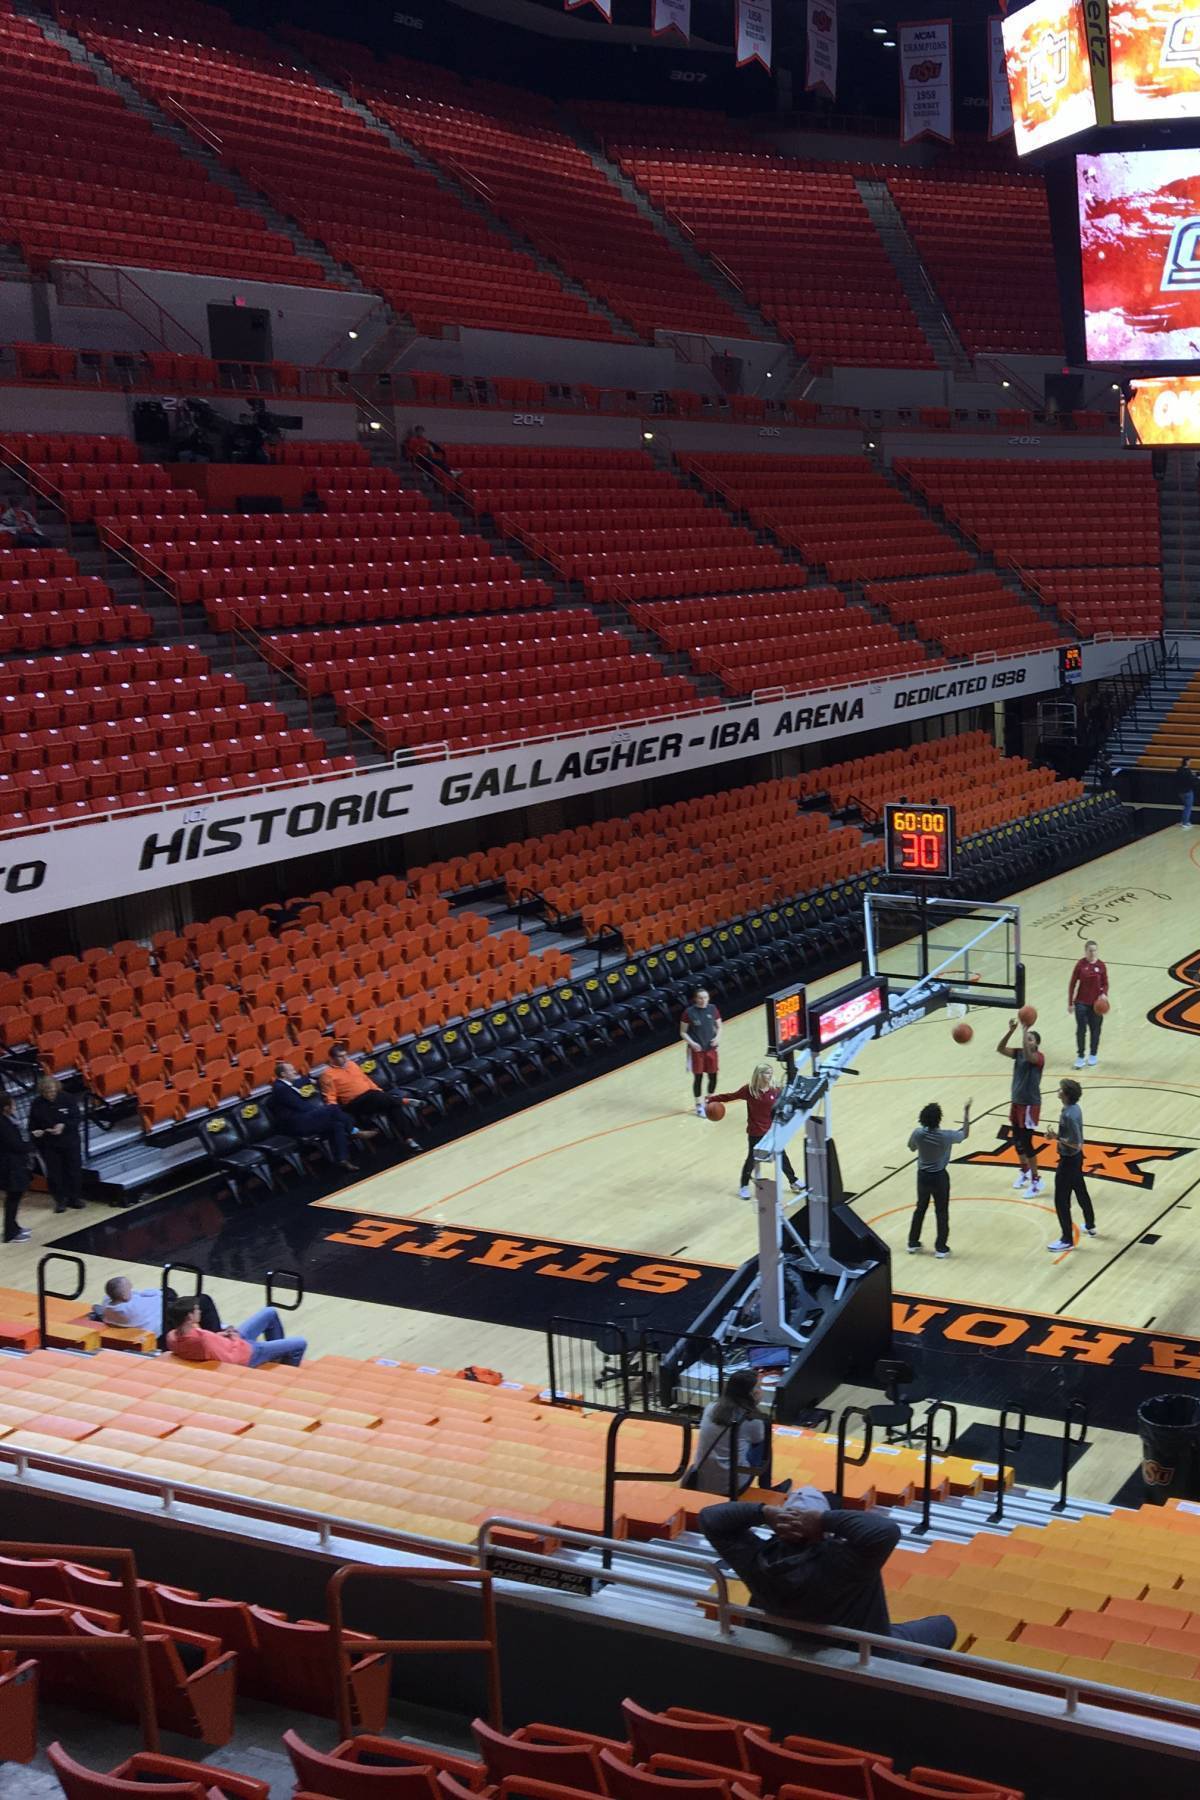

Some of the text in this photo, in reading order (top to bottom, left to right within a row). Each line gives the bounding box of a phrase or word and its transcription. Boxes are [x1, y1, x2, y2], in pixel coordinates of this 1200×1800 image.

[1086, 0, 1106, 68] ertz
[670, 70, 707, 82] 307
[512, 414, 545, 426] 204
[0, 860, 46, 893] O
[139, 784, 413, 870] HISTORIC
[773, 697, 864, 736] ARENA
[894, 676, 987, 709] DEDICATED
[992, 668, 1026, 689] 1938
[894, 812, 945, 833] 60:00
[902, 834, 939, 869] 30
[780, 1015, 799, 1041] 30
[324, 1218, 702, 1294] STATE
[1142, 1459, 1175, 1486] SU
